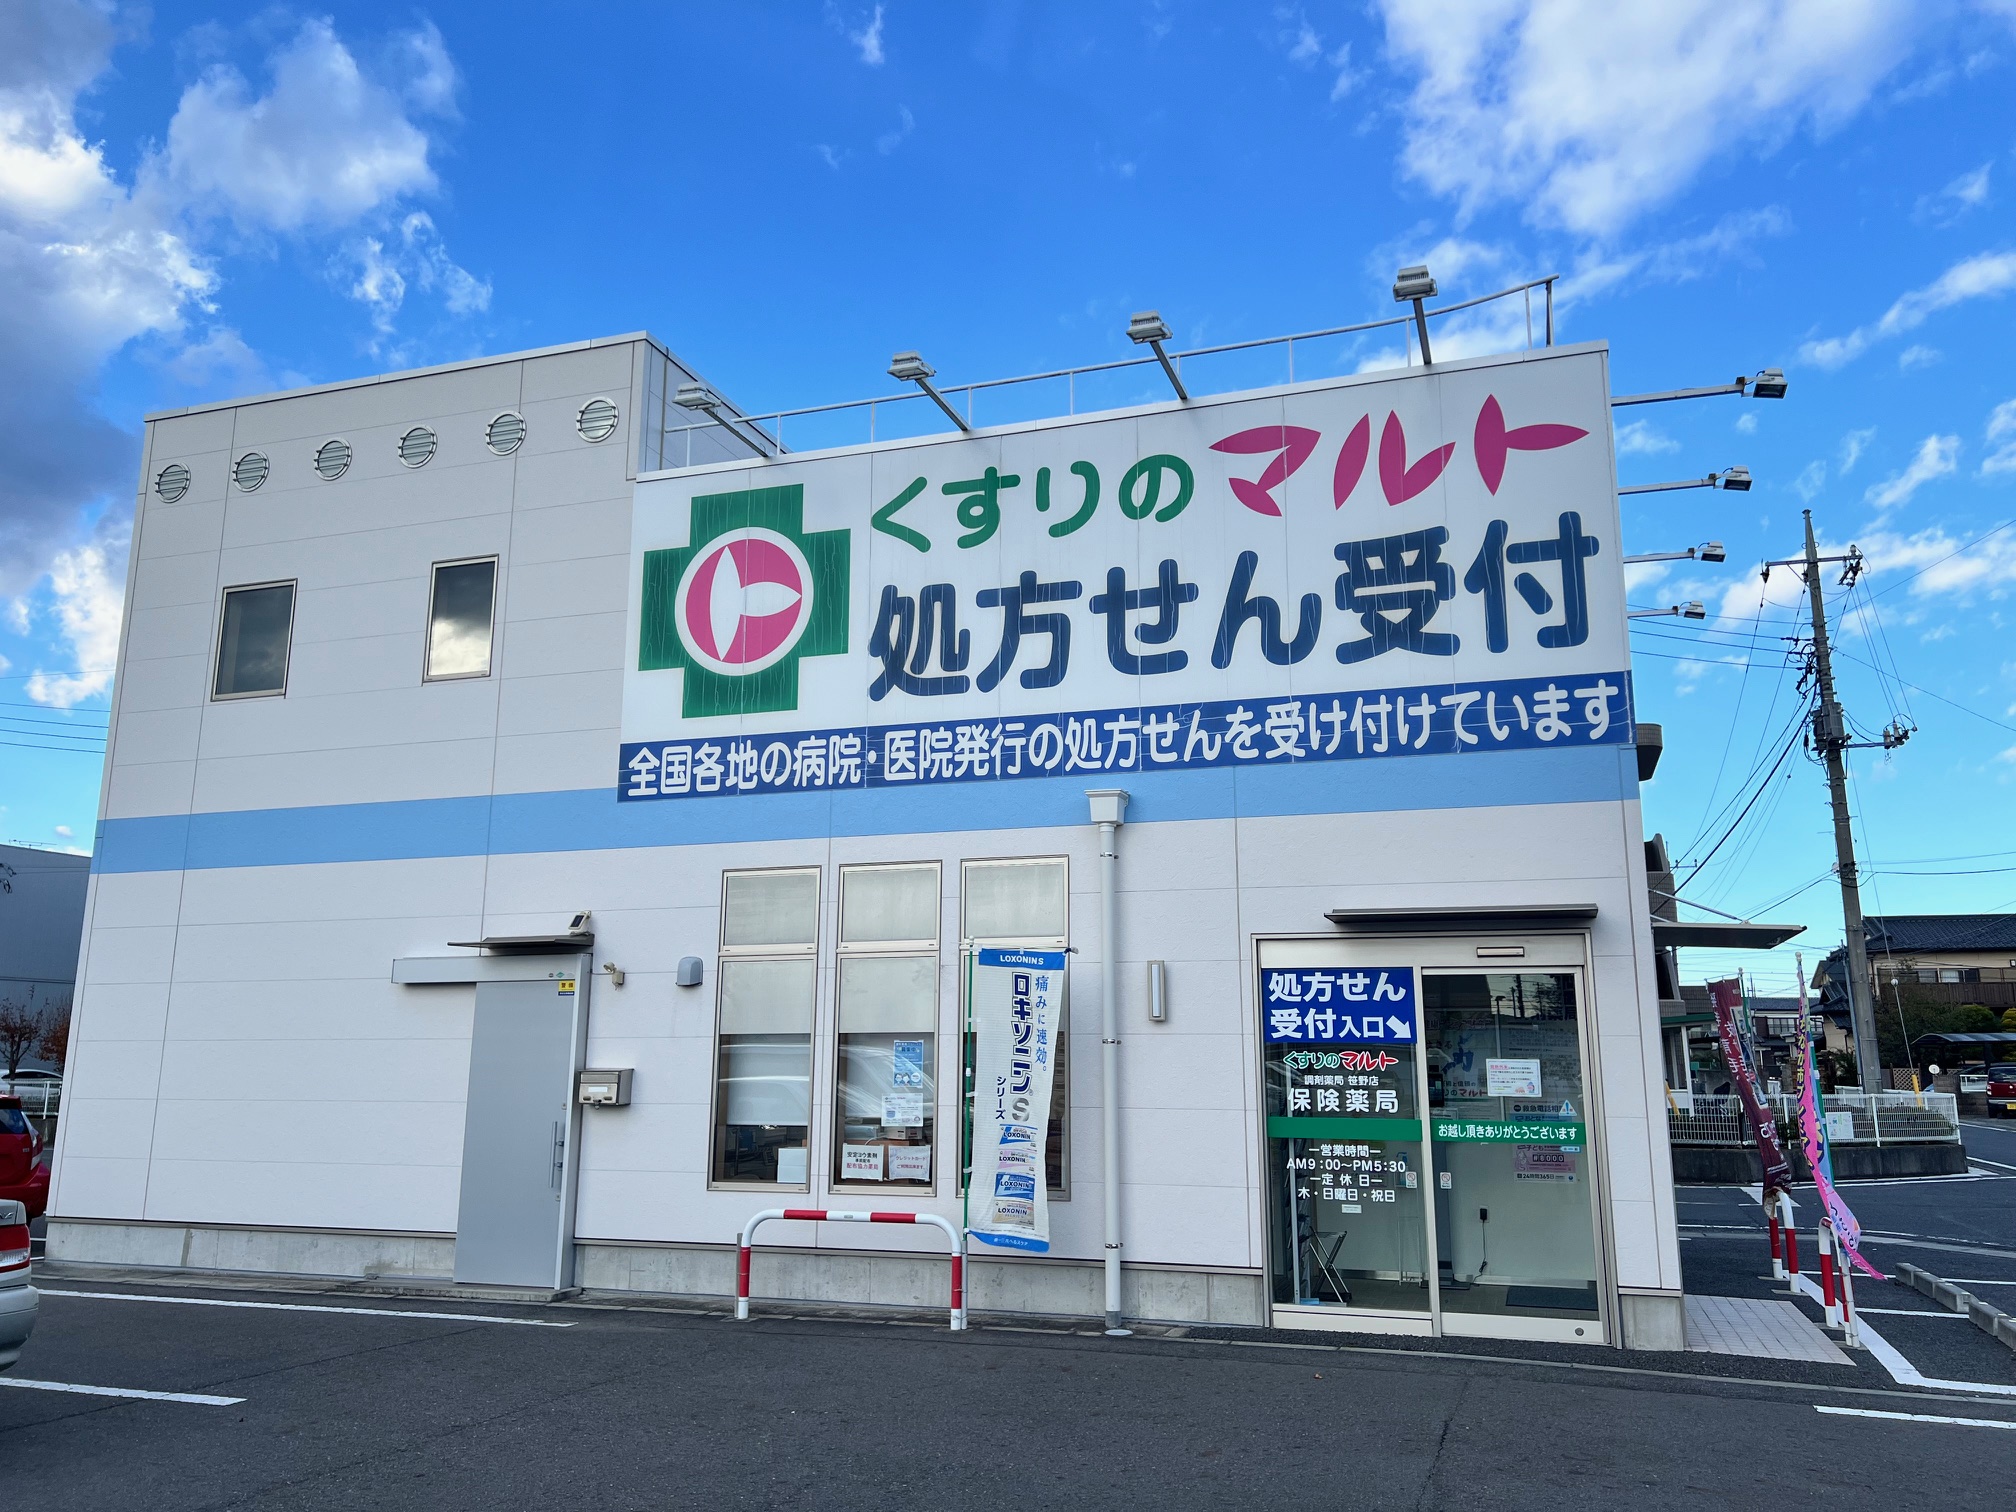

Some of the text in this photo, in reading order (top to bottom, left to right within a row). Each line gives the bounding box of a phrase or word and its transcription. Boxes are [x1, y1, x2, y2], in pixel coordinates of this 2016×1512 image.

[868, 511, 1600, 701] 処方せん受付
[626, 679, 1619, 798] 全国各地の病院・医院発行の処方せんを受け付けています
[1268, 972, 1406, 1003] 処方せん
[1270, 1008, 1384, 1039] 受付入口
[1283, 1051, 1399, 1071] くすりのマルト
[995, 1077, 1007, 1120] シリーズ
[1287, 1088, 1398, 1114] 保険薬局
[1438, 1124, 1577, 1140] お越し頂きありがとうございます
